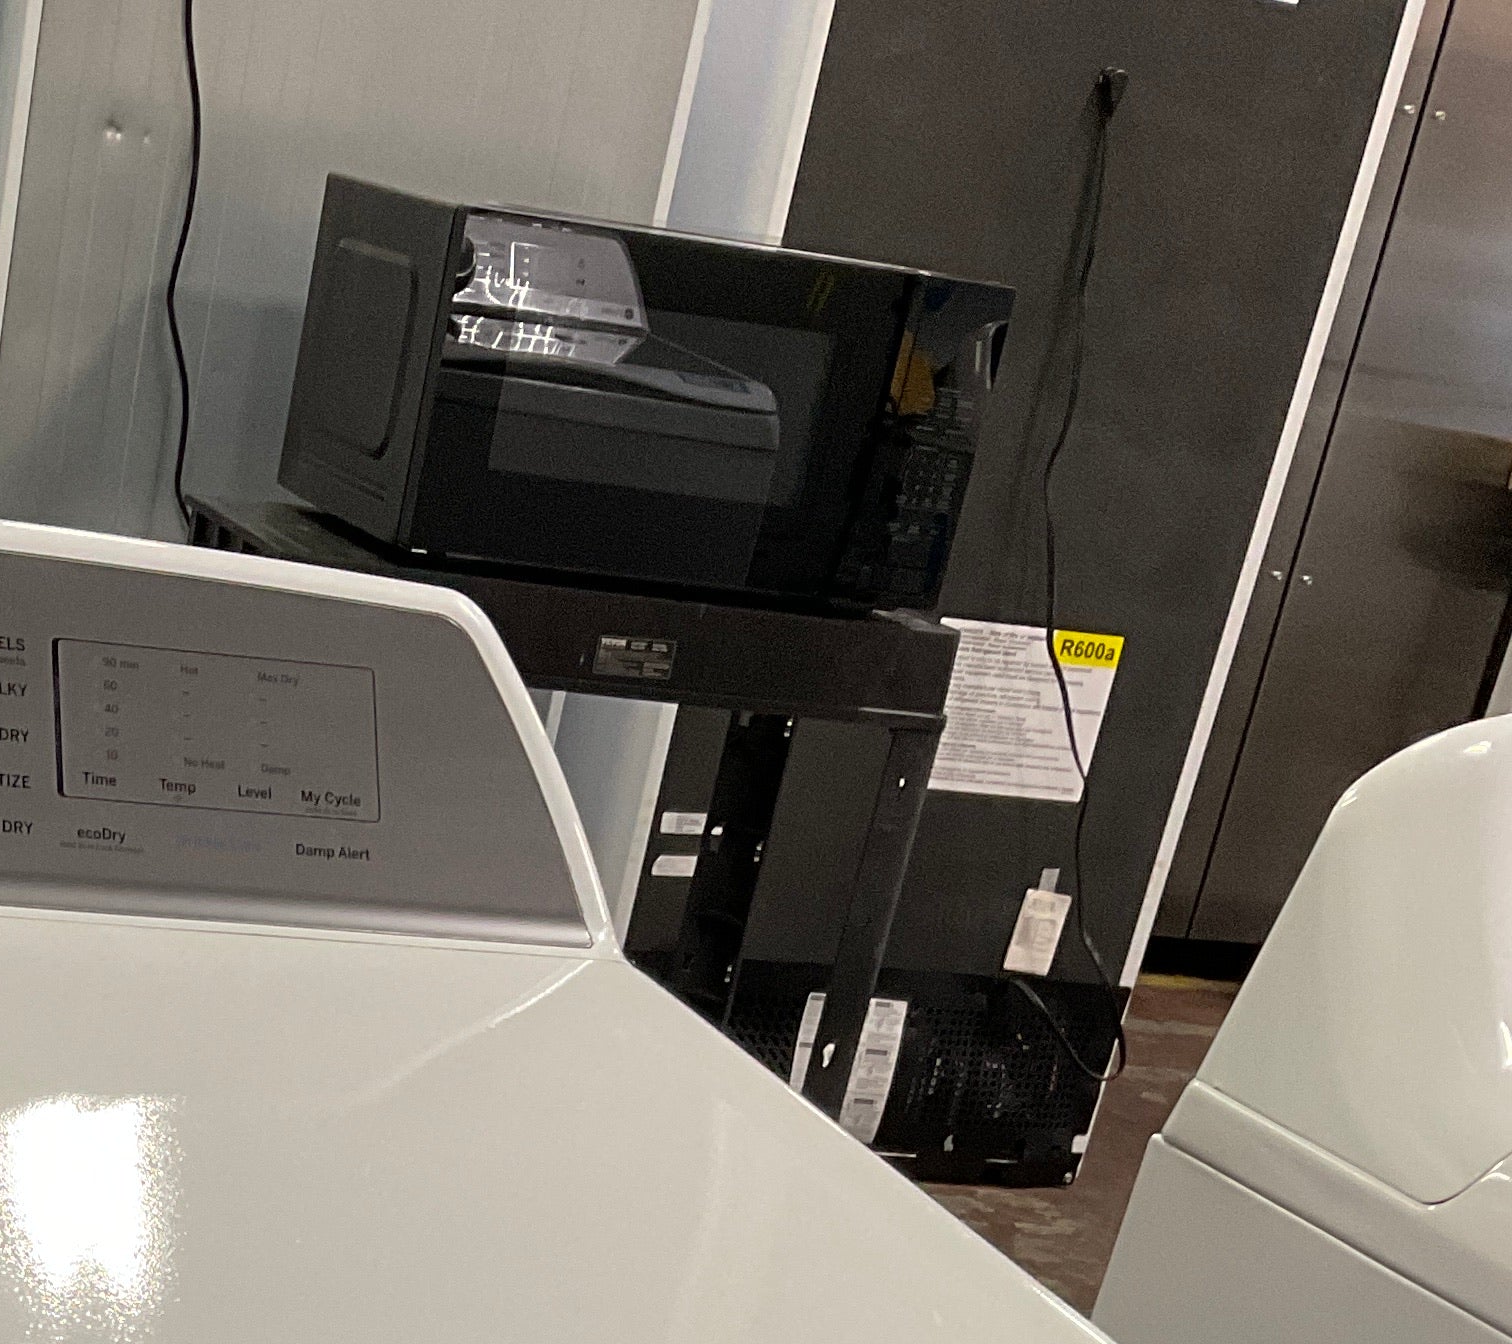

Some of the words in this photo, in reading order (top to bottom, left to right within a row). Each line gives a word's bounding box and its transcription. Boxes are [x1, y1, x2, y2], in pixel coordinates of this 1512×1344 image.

[1059, 638, 1116, 661] R600a
[82, 771, 118, 788] Time
[159, 778, 196, 796] Temp
[237, 784, 272, 800] Level
[300, 789, 321, 807] My
[324, 791, 362, 808] Cycle
[2, 819, 33, 836] DRY
[76, 827, 127, 845] ecoDry
[295, 843, 335, 861] Damp
[338, 846, 371, 862] Alert
